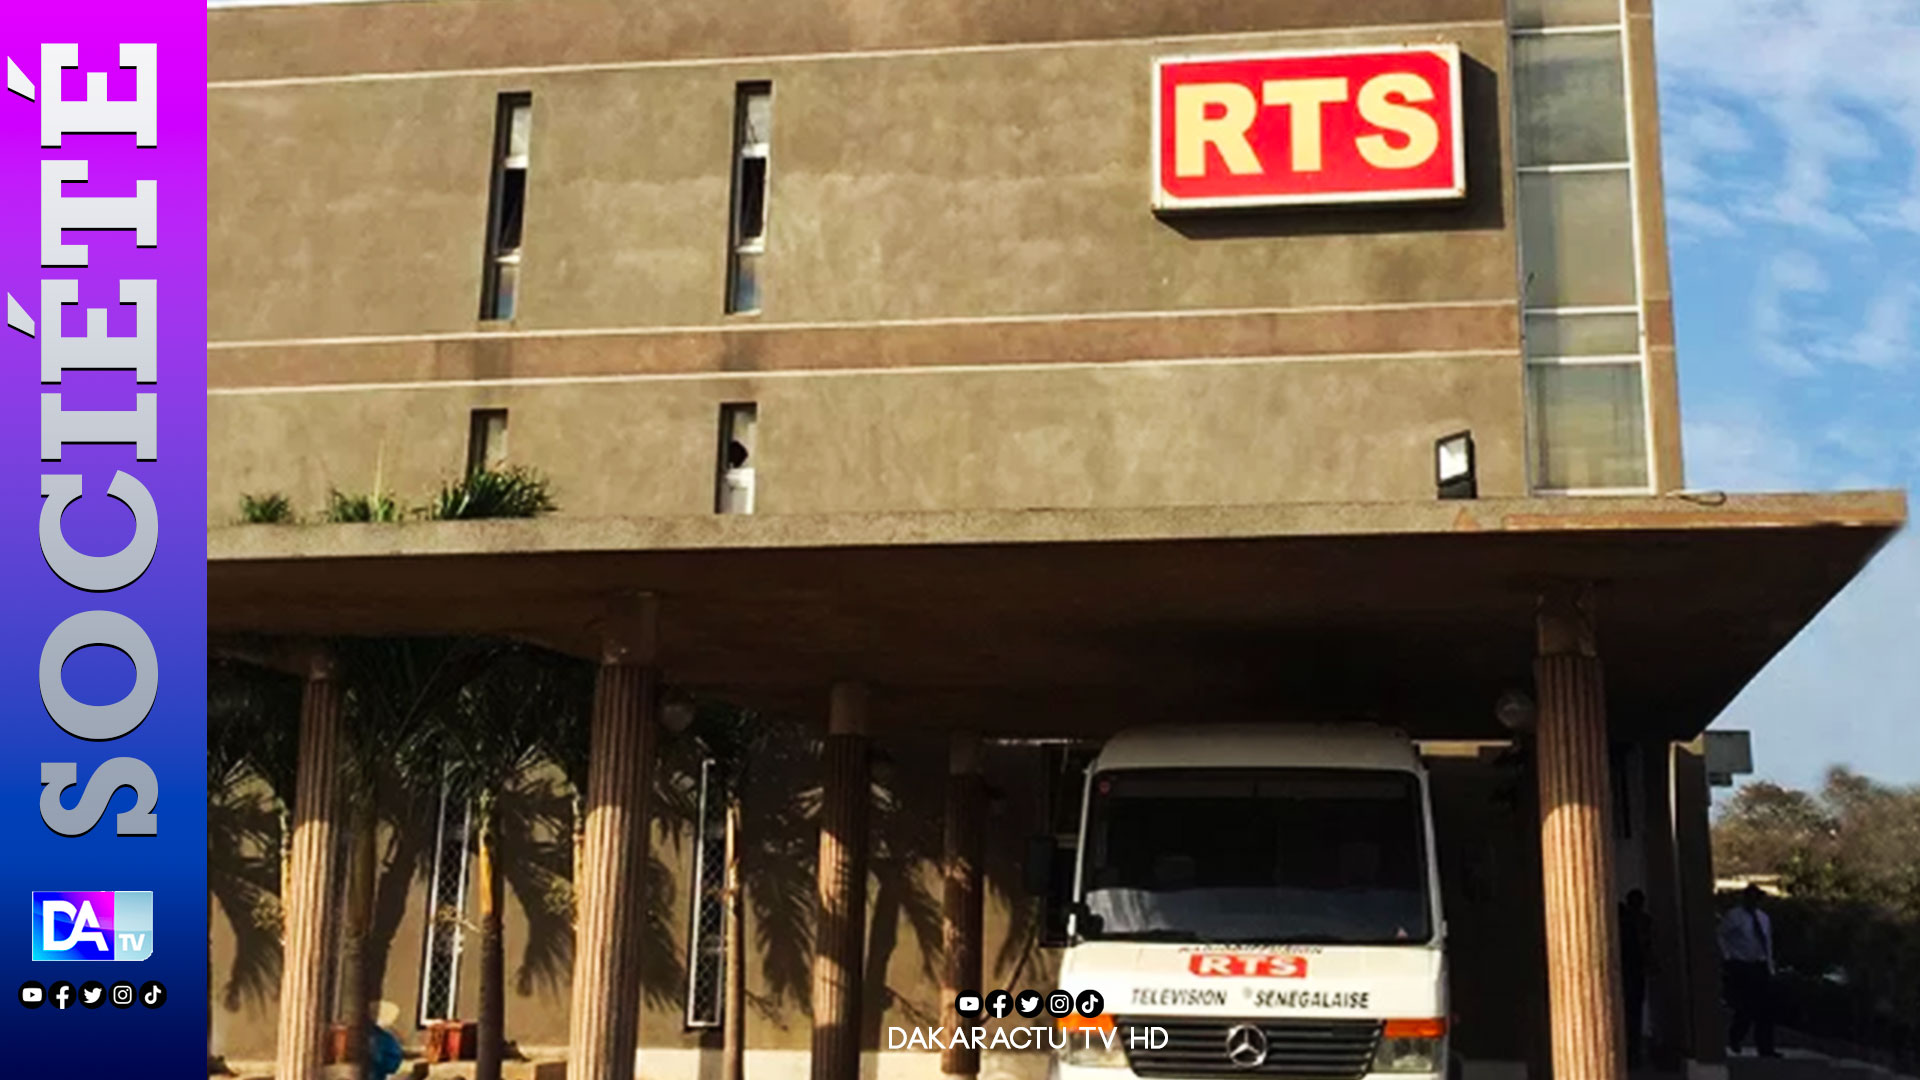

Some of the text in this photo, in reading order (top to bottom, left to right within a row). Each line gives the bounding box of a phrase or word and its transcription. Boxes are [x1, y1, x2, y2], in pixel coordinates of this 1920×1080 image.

[1175, 72, 1439, 178] RTS
[1199, 955, 1298, 976] RTS
[1131, 988, 1370, 1009] TELEVISION SENEGALAISE
